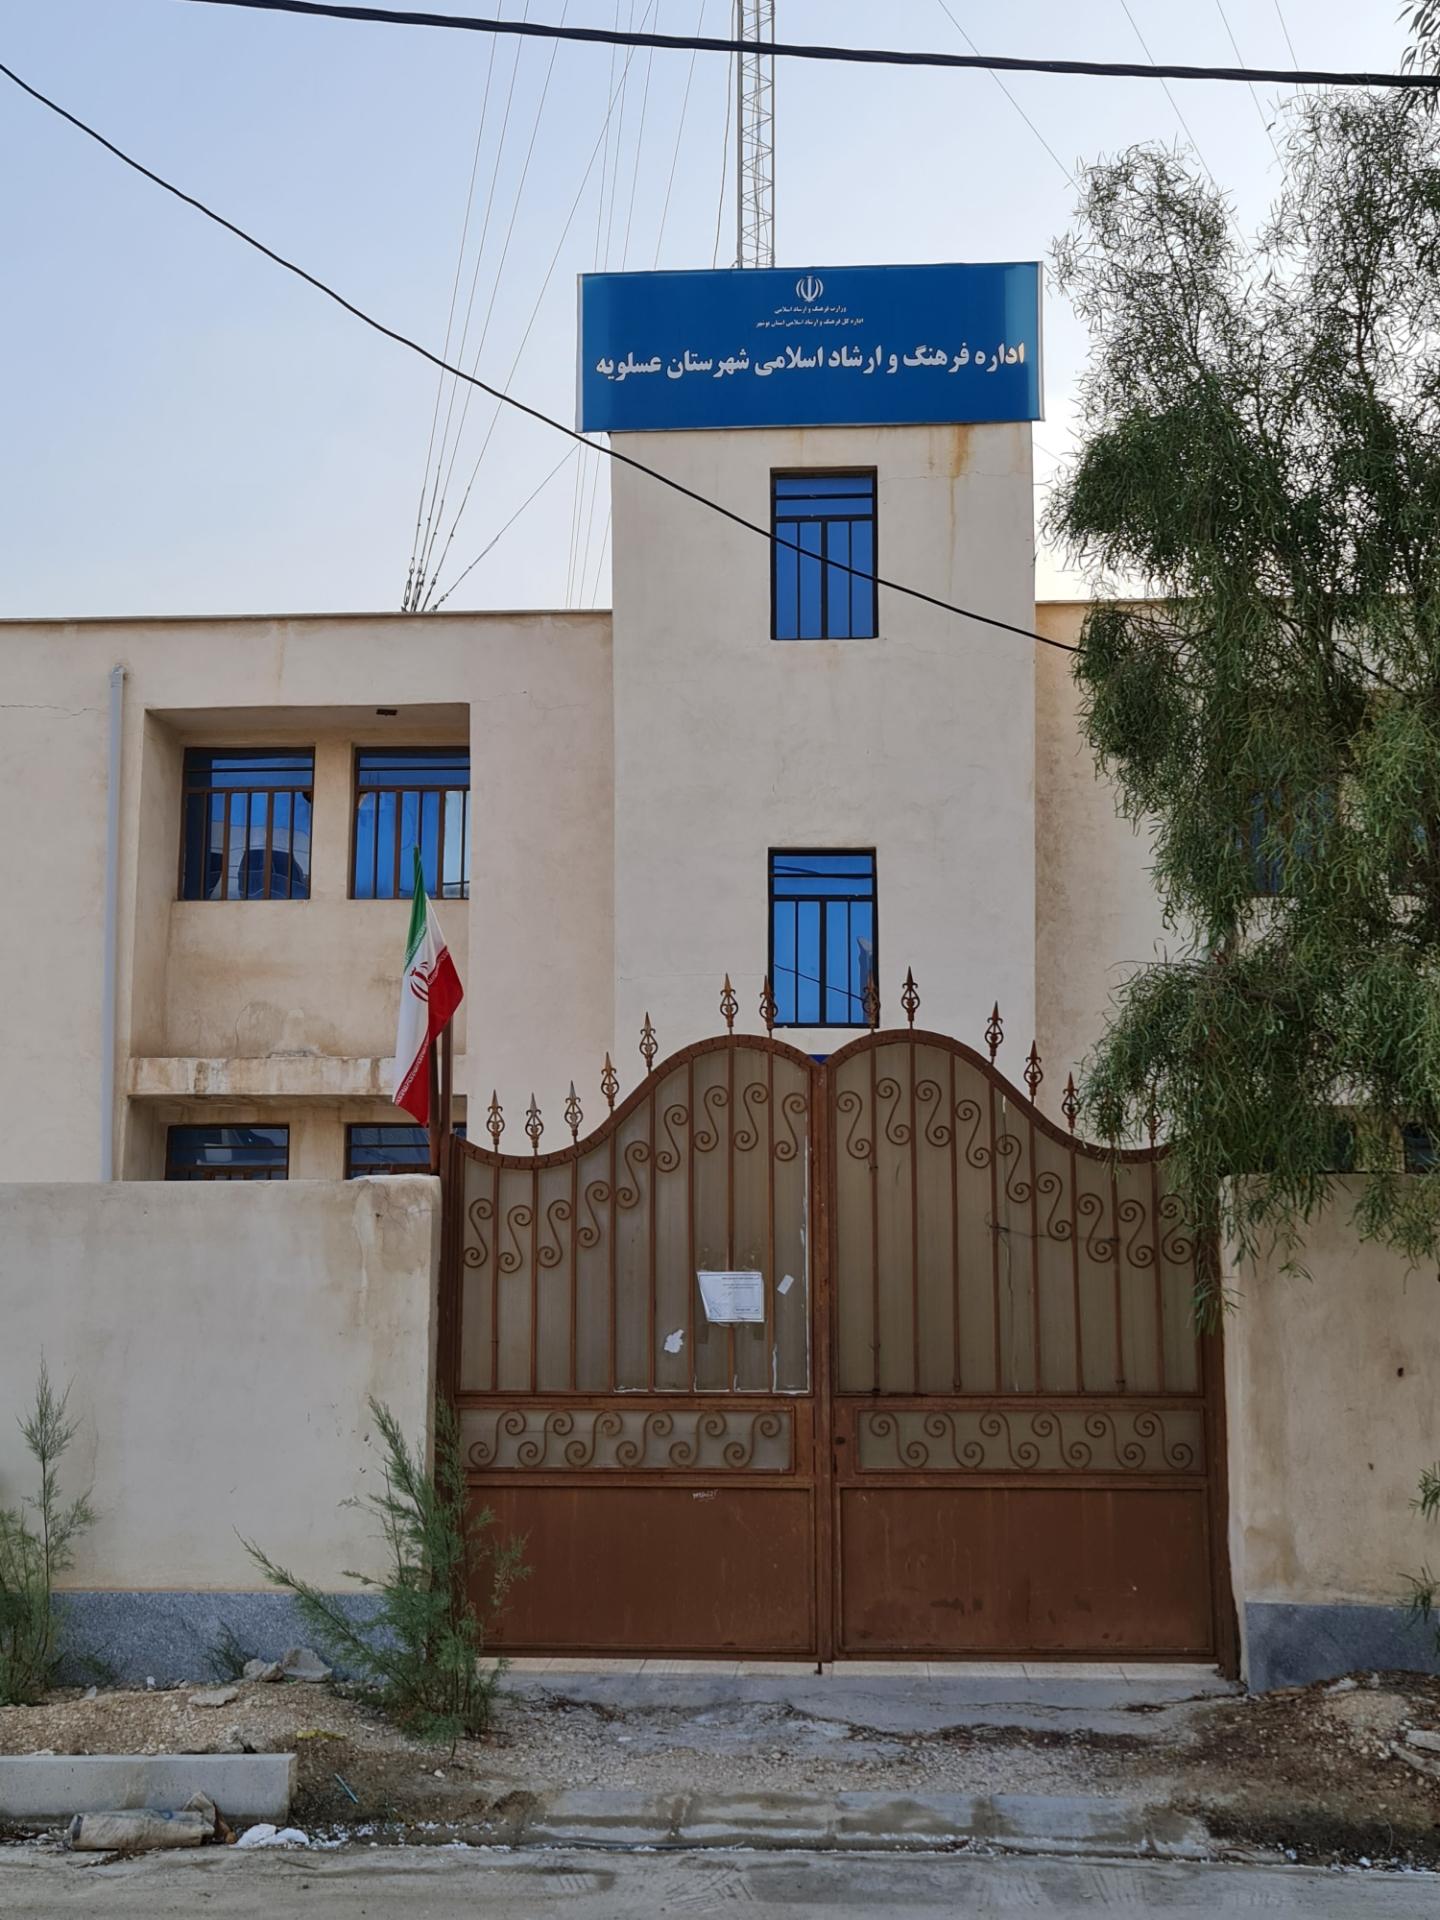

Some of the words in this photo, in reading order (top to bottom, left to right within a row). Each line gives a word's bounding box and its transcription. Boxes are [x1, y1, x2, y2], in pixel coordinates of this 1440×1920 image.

[595, 352, 662, 381] عسلویه
[666, 348, 750, 379] شهرستان
[754, 345, 824, 376] اسلامی
[828, 344, 882, 374] ارشاد
[886, 353, 898, 374] و
[902, 342, 970, 373] فرهنگ
[974, 342, 1025, 372] اداره
